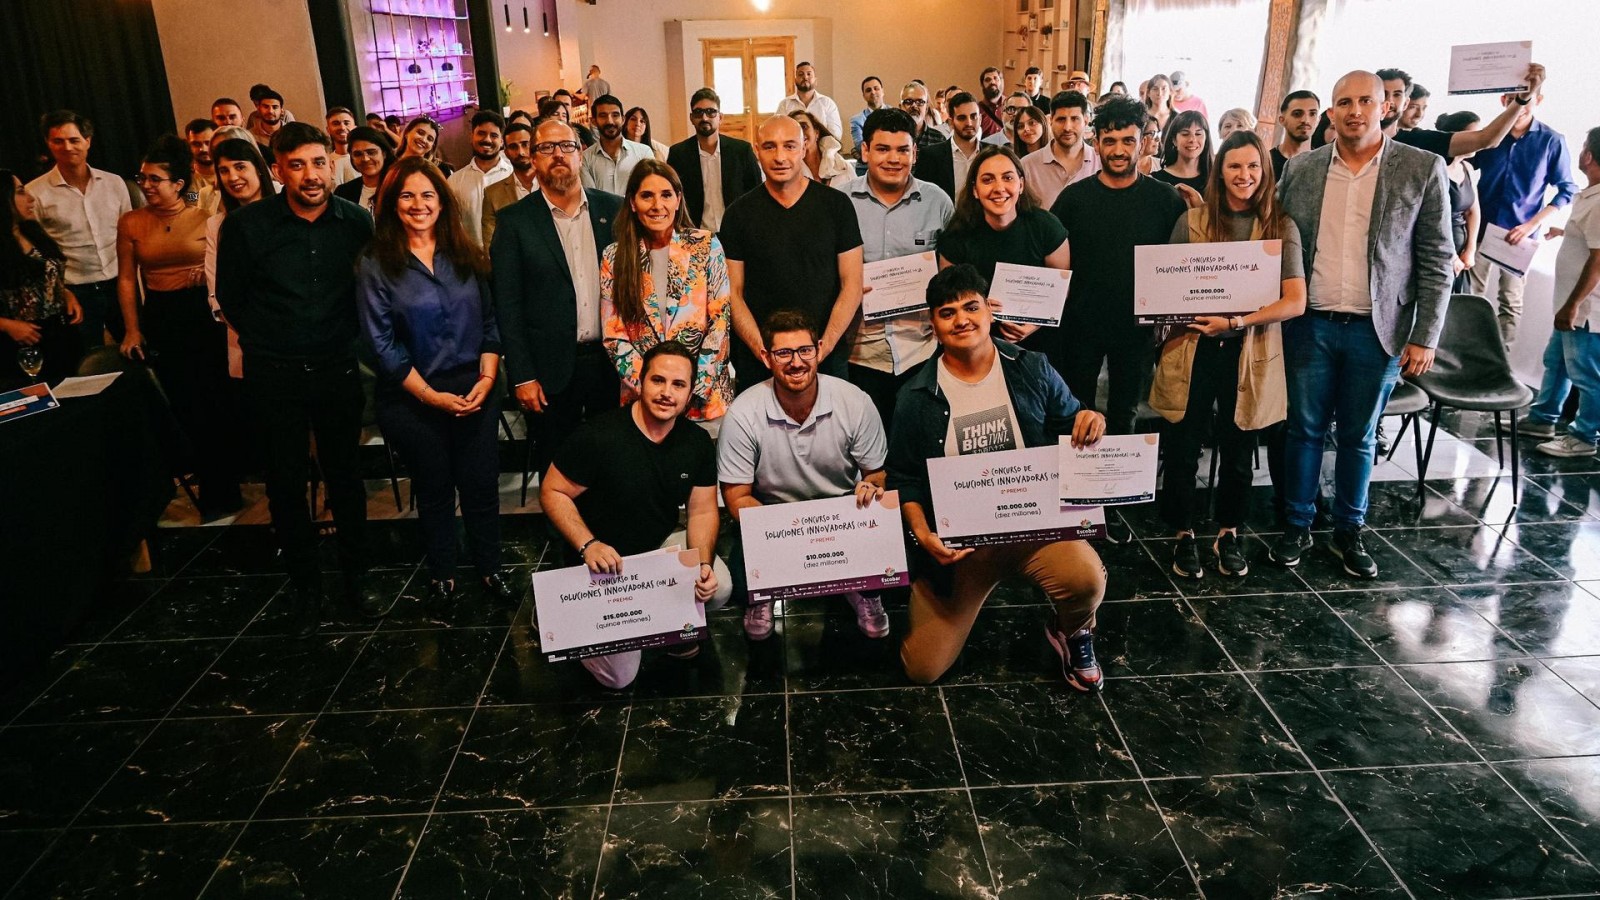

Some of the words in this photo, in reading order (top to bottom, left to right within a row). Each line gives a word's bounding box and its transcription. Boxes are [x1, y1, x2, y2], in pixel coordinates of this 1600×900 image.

[1155, 265, 1191, 274] SOLUCIONES
[1193, 263, 1238, 273] INNOVADORAS
[962, 417, 1007, 440] THINK
[962, 435, 988, 452] BIG
[991, 465, 1022, 476] CONCURSO
[1024, 464, 1032, 472] DE
[954, 476, 994, 490] SOLUCIONES
[997, 471, 1049, 486] INNOVADORAS
[996, 501, 1037, 511] $10.000.000
[801, 514, 830, 525] CONCURSO
[832, 513, 840, 522] DE
[994, 510, 1010, 520] (diez
[1011, 508, 1042, 518] millones)
[765, 526, 804, 540] SOLUCIONES
[806, 520, 856, 535] INNOVADORAS
[857, 520, 868, 529] CON
[1076, 528, 1098, 536] Escobar
[816, 536, 836, 544] PREMIO
[806, 550, 845, 560] $10.000.000
[803, 561, 818, 569] (diez
[820, 557, 848, 568] millones)
[598, 576, 628, 586] CONCURSO
[560, 588, 601, 604] SOLUCIONES
[604, 580, 654, 596] INNOVADORAS
[656, 580, 666, 588] CON
[612, 596, 634, 604] PREMIO
[602, 609, 642, 621] $15.000.000
[596, 620, 620, 630] (quince
[622, 614, 651, 625] millones)
[680, 630, 699, 638] Escobar
